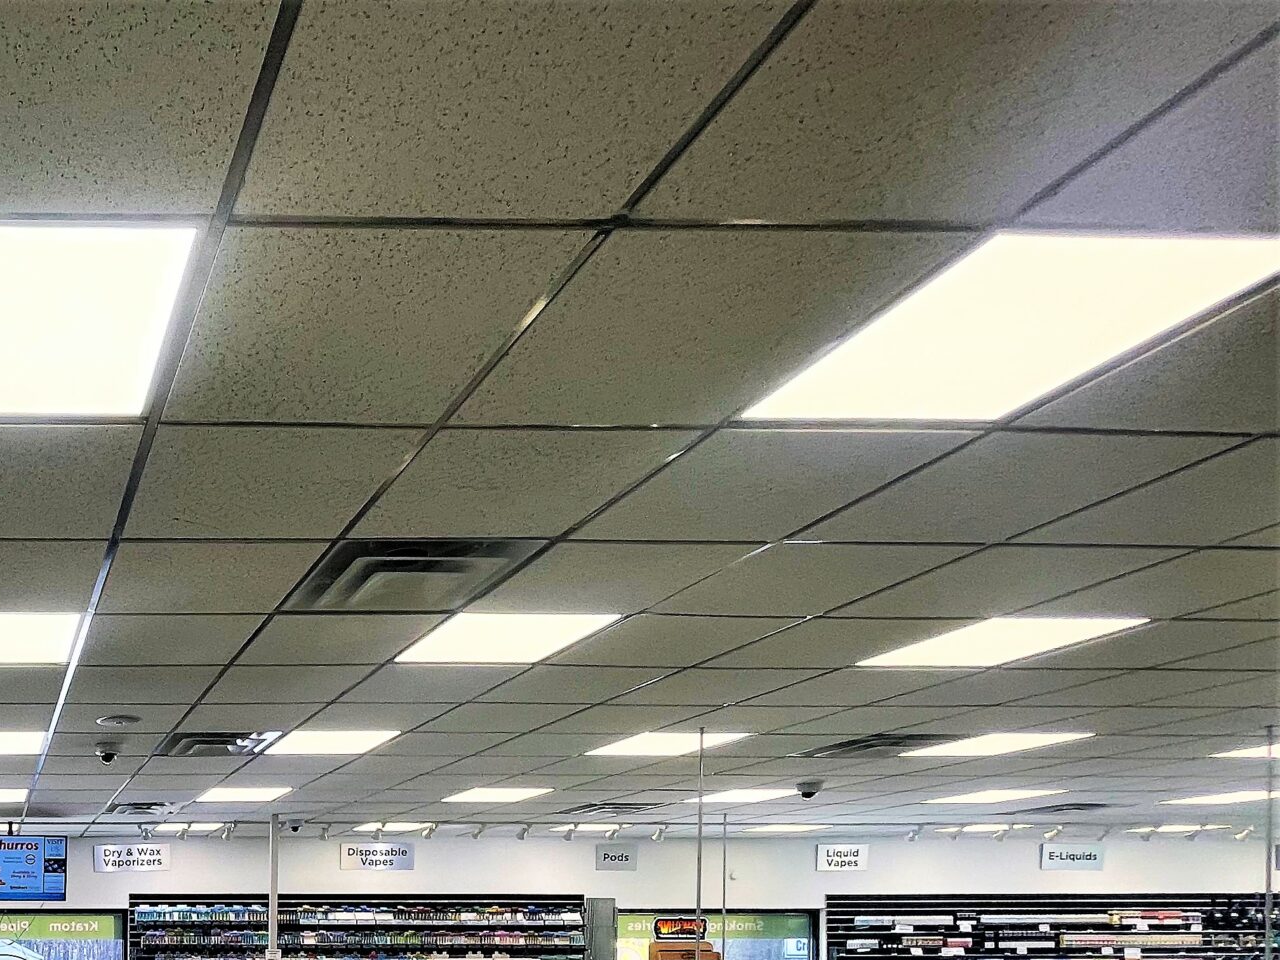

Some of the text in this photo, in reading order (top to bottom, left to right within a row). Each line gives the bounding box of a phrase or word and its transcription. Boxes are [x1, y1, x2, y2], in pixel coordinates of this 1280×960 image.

[104, 848, 161, 858] Dry & Wax
[347, 847, 408, 857] Disposable
[826, 849, 859, 859] Liquid
[1048, 851, 1098, 862] E-Liquids
[360, 857, 394, 867] Vapes
[603, 853, 630, 862] Pods
[103, 858, 163, 868] Vaporizers
[826, 858, 859, 868] Vapes
